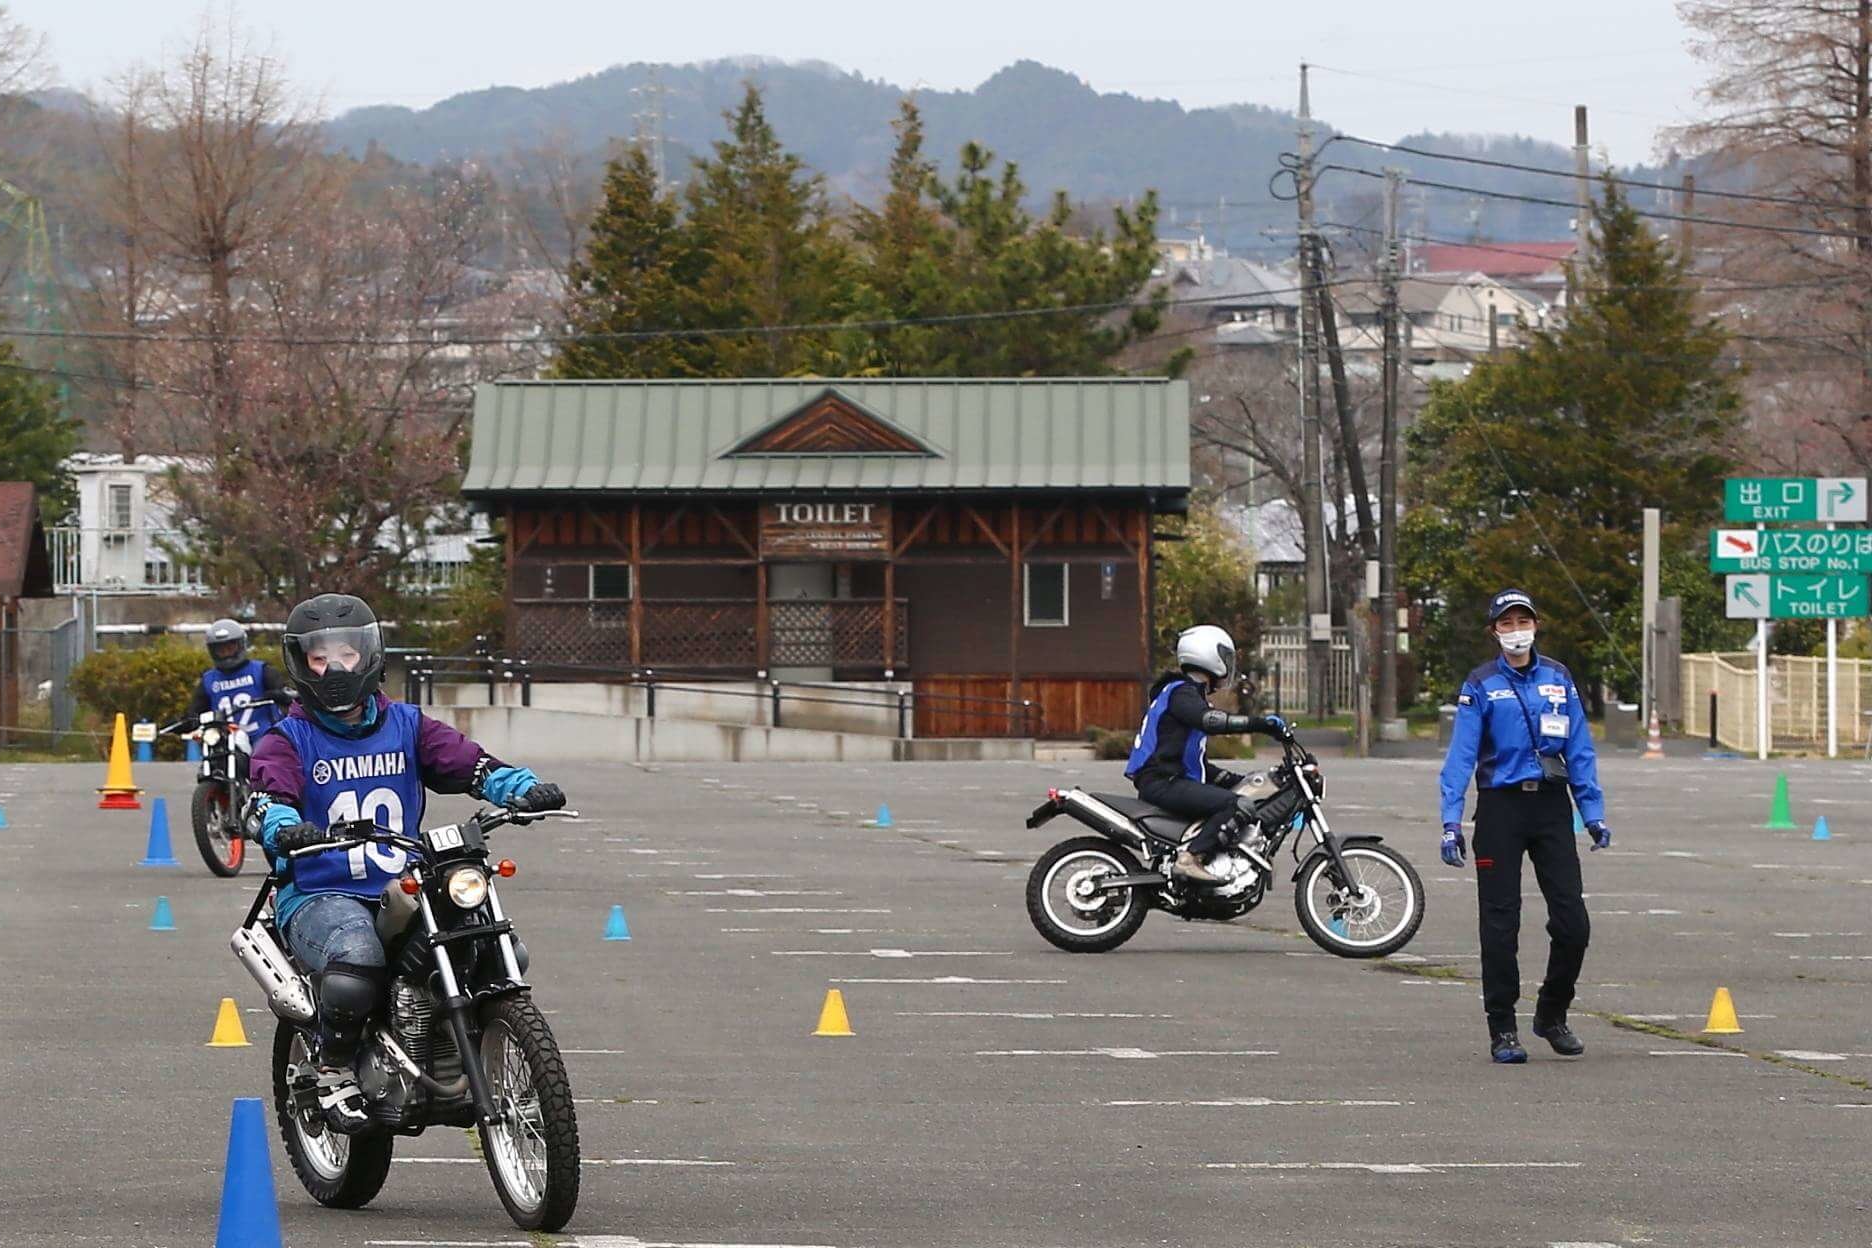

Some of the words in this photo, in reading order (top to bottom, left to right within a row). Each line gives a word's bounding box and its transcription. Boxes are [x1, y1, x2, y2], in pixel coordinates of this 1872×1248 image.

[1740, 482, 1804, 505] 出口
[775, 503, 875, 523] TOILET
[1753, 506, 1790, 519] EXIT
[1740, 557, 1772, 570] BUS
[1779, 557, 1820, 570] STOP
[1827, 558, 1859, 570] No.1
[1777, 578, 1860, 600] トイレ
[1789, 602, 1848, 615] TOILET
[218, 692, 258, 732] 12
[330, 752, 405, 781] YAMAHA
[328, 788, 406, 880] 10
[432, 828, 460, 848] 10
